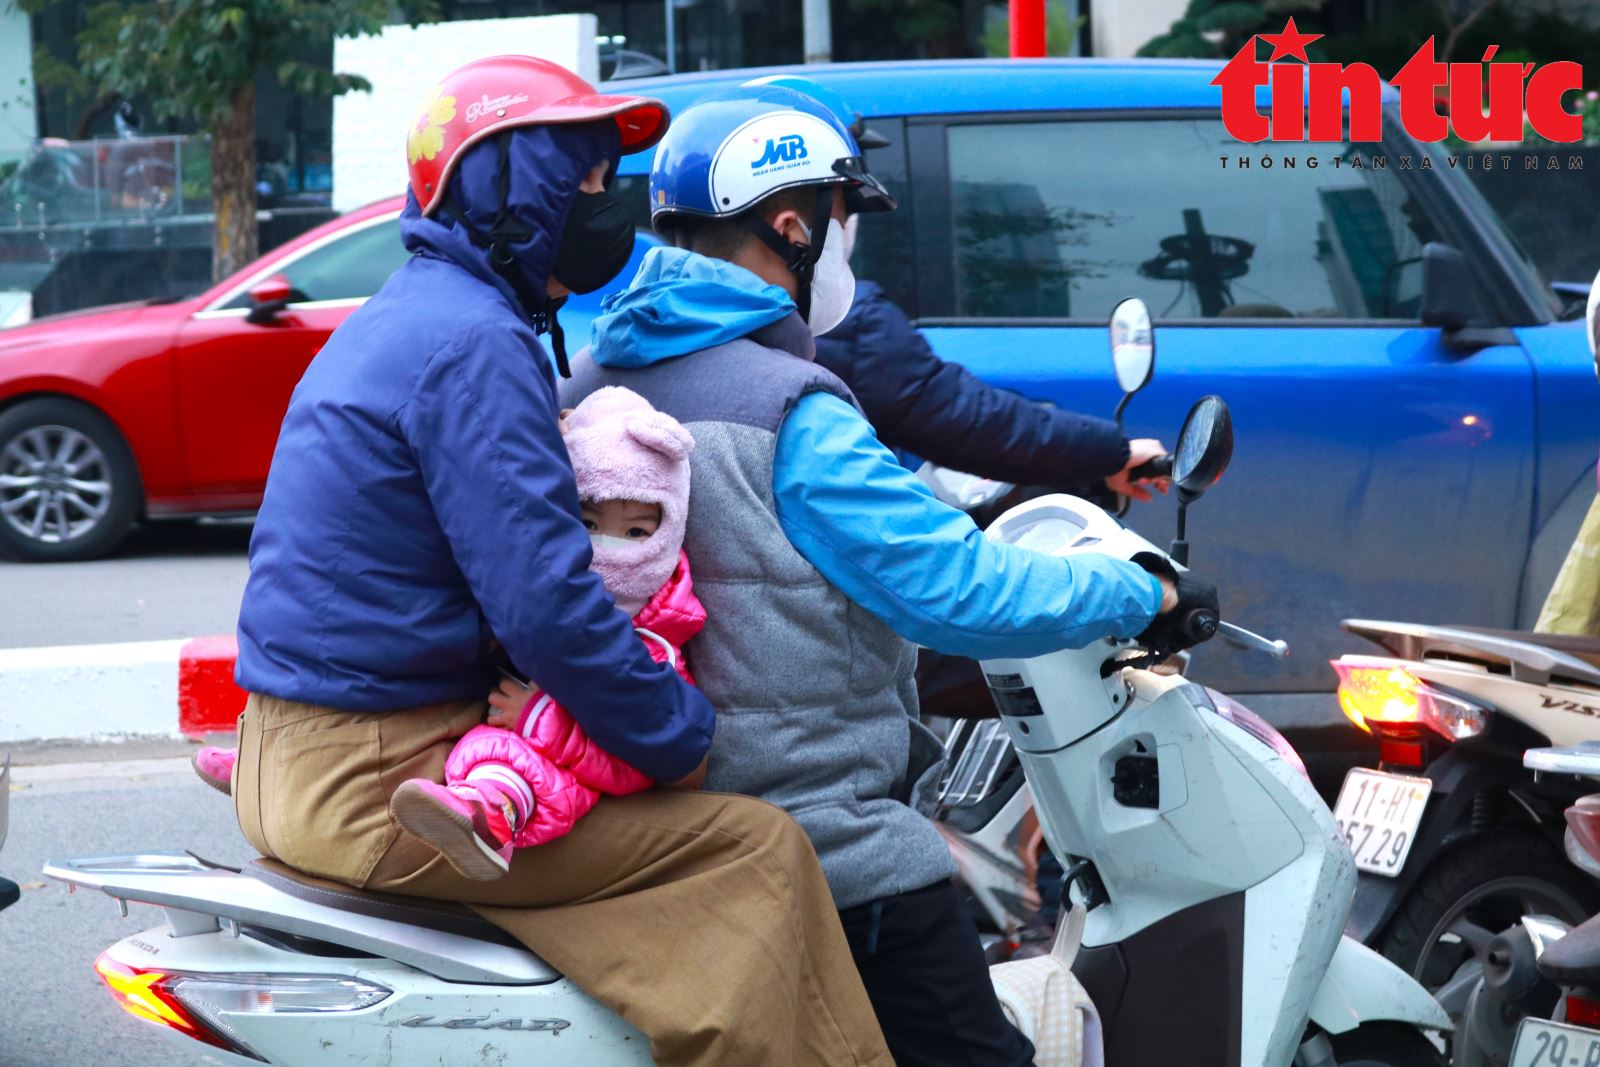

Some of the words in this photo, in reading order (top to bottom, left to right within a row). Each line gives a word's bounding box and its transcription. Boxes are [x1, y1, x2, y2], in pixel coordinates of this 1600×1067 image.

[751, 134, 808, 168] MB
[1539, 693, 1600, 718] VIS
[1352, 779, 1417, 825] 11-H1
